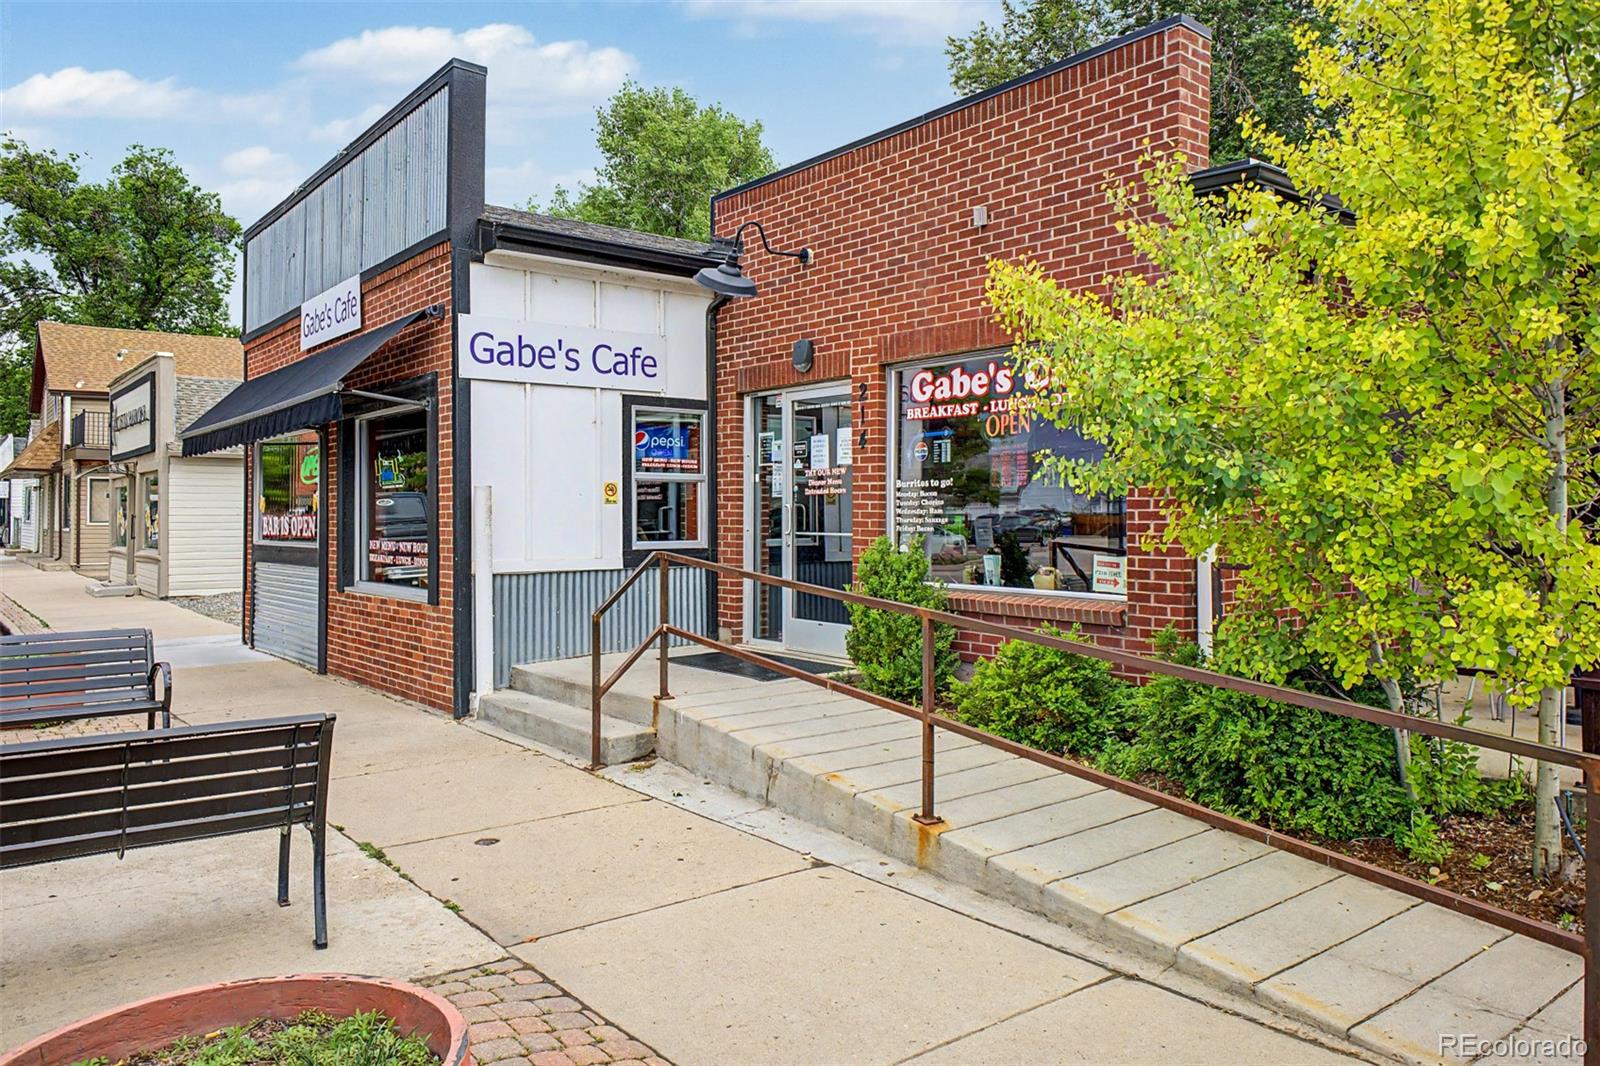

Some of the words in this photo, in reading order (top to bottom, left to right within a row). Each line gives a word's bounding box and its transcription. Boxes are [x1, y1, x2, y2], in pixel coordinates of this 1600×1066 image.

[303, 303, 332, 338] Gabe's
[334, 290, 358, 324] Cafe
[469, 331, 581, 372] Gabe's
[591, 343, 658, 378] Cafe
[911, 361, 1013, 402] Gabe's
[858, 382, 868, 449] 214
[906, 402, 979, 420] BREAKFAST
[985, 412, 1030, 437] OPEN
[651, 436, 684, 449] pepsi
[831, 467, 847, 475] NEW
[896, 479, 929, 488] Burritos
[930, 479, 939, 487] to
[940, 477, 954, 488] go!
[262, 515, 279, 535] BAR
[280, 515, 289, 536] IS
[290, 515, 316, 537] OPEN
